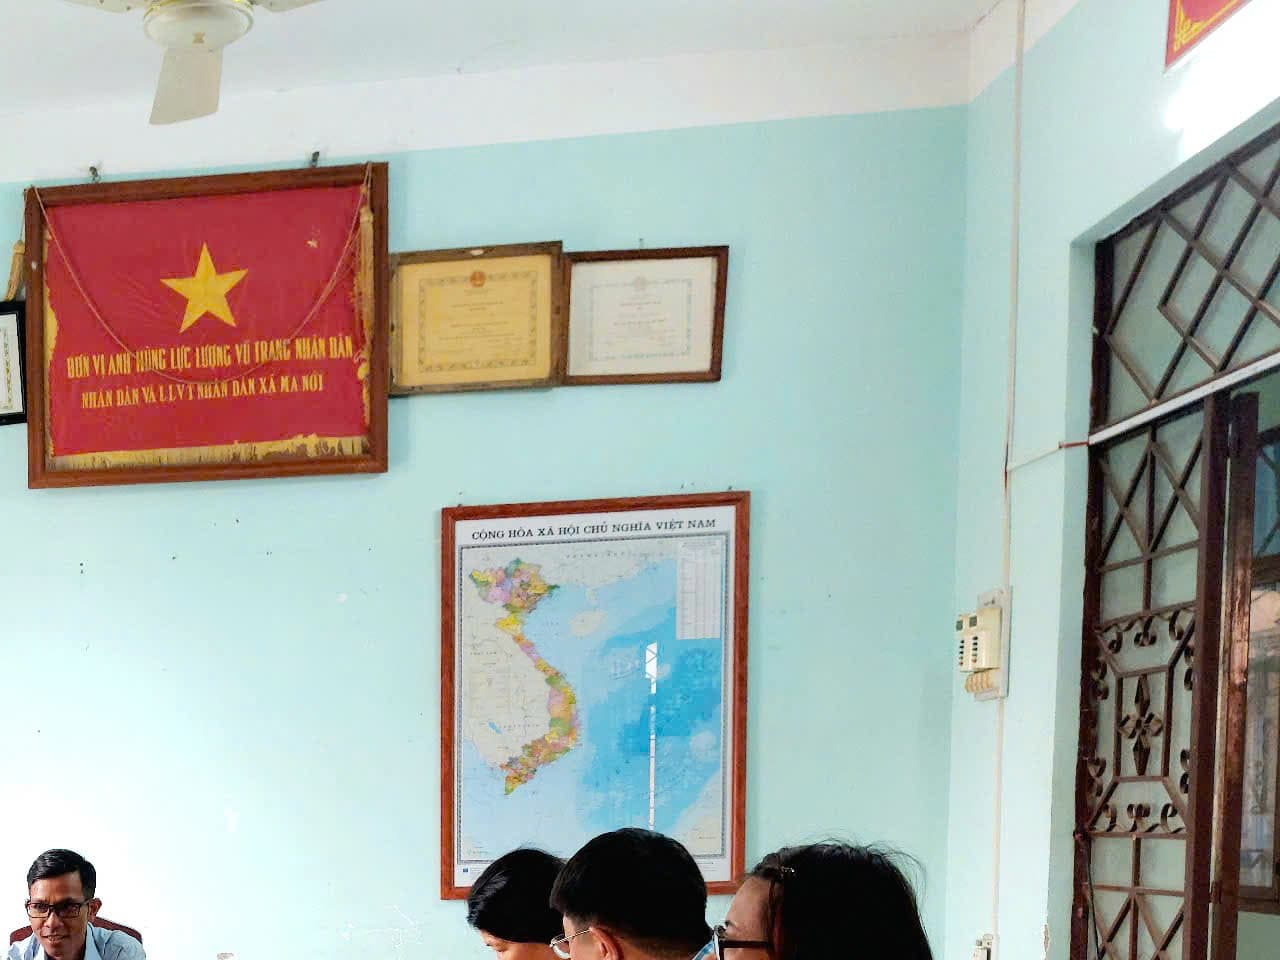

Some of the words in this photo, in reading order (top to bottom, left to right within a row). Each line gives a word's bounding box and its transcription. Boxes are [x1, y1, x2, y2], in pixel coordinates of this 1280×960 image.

[92, 353, 105, 379] VỊ
[108, 352, 131, 375] ANH
[170, 345, 191, 371] LỰC
[254, 339, 291, 363] TRANG
[295, 334, 326, 360] NHÂN
[328, 333, 353, 359] DÂN
[81, 388, 113, 409] NHÂN
[116, 385, 139, 407] DÂN
[141, 384, 156, 404] VÀ
[197, 378, 228, 400] NHÂN
[231, 376, 256, 397] DÂN
[280, 375, 298, 393] MA
[471, 528, 505, 541] CỘNG
[508, 526, 534, 539] HÒA
[537, 524, 555, 537] XÃ
[558, 523, 580, 537] HỘI
[583, 521, 608, 534] CHỦ
[611, 521, 652, 533] NGHĨA
[656, 518, 685, 531] VIỆT
[687, 518, 716, 529] NAM
